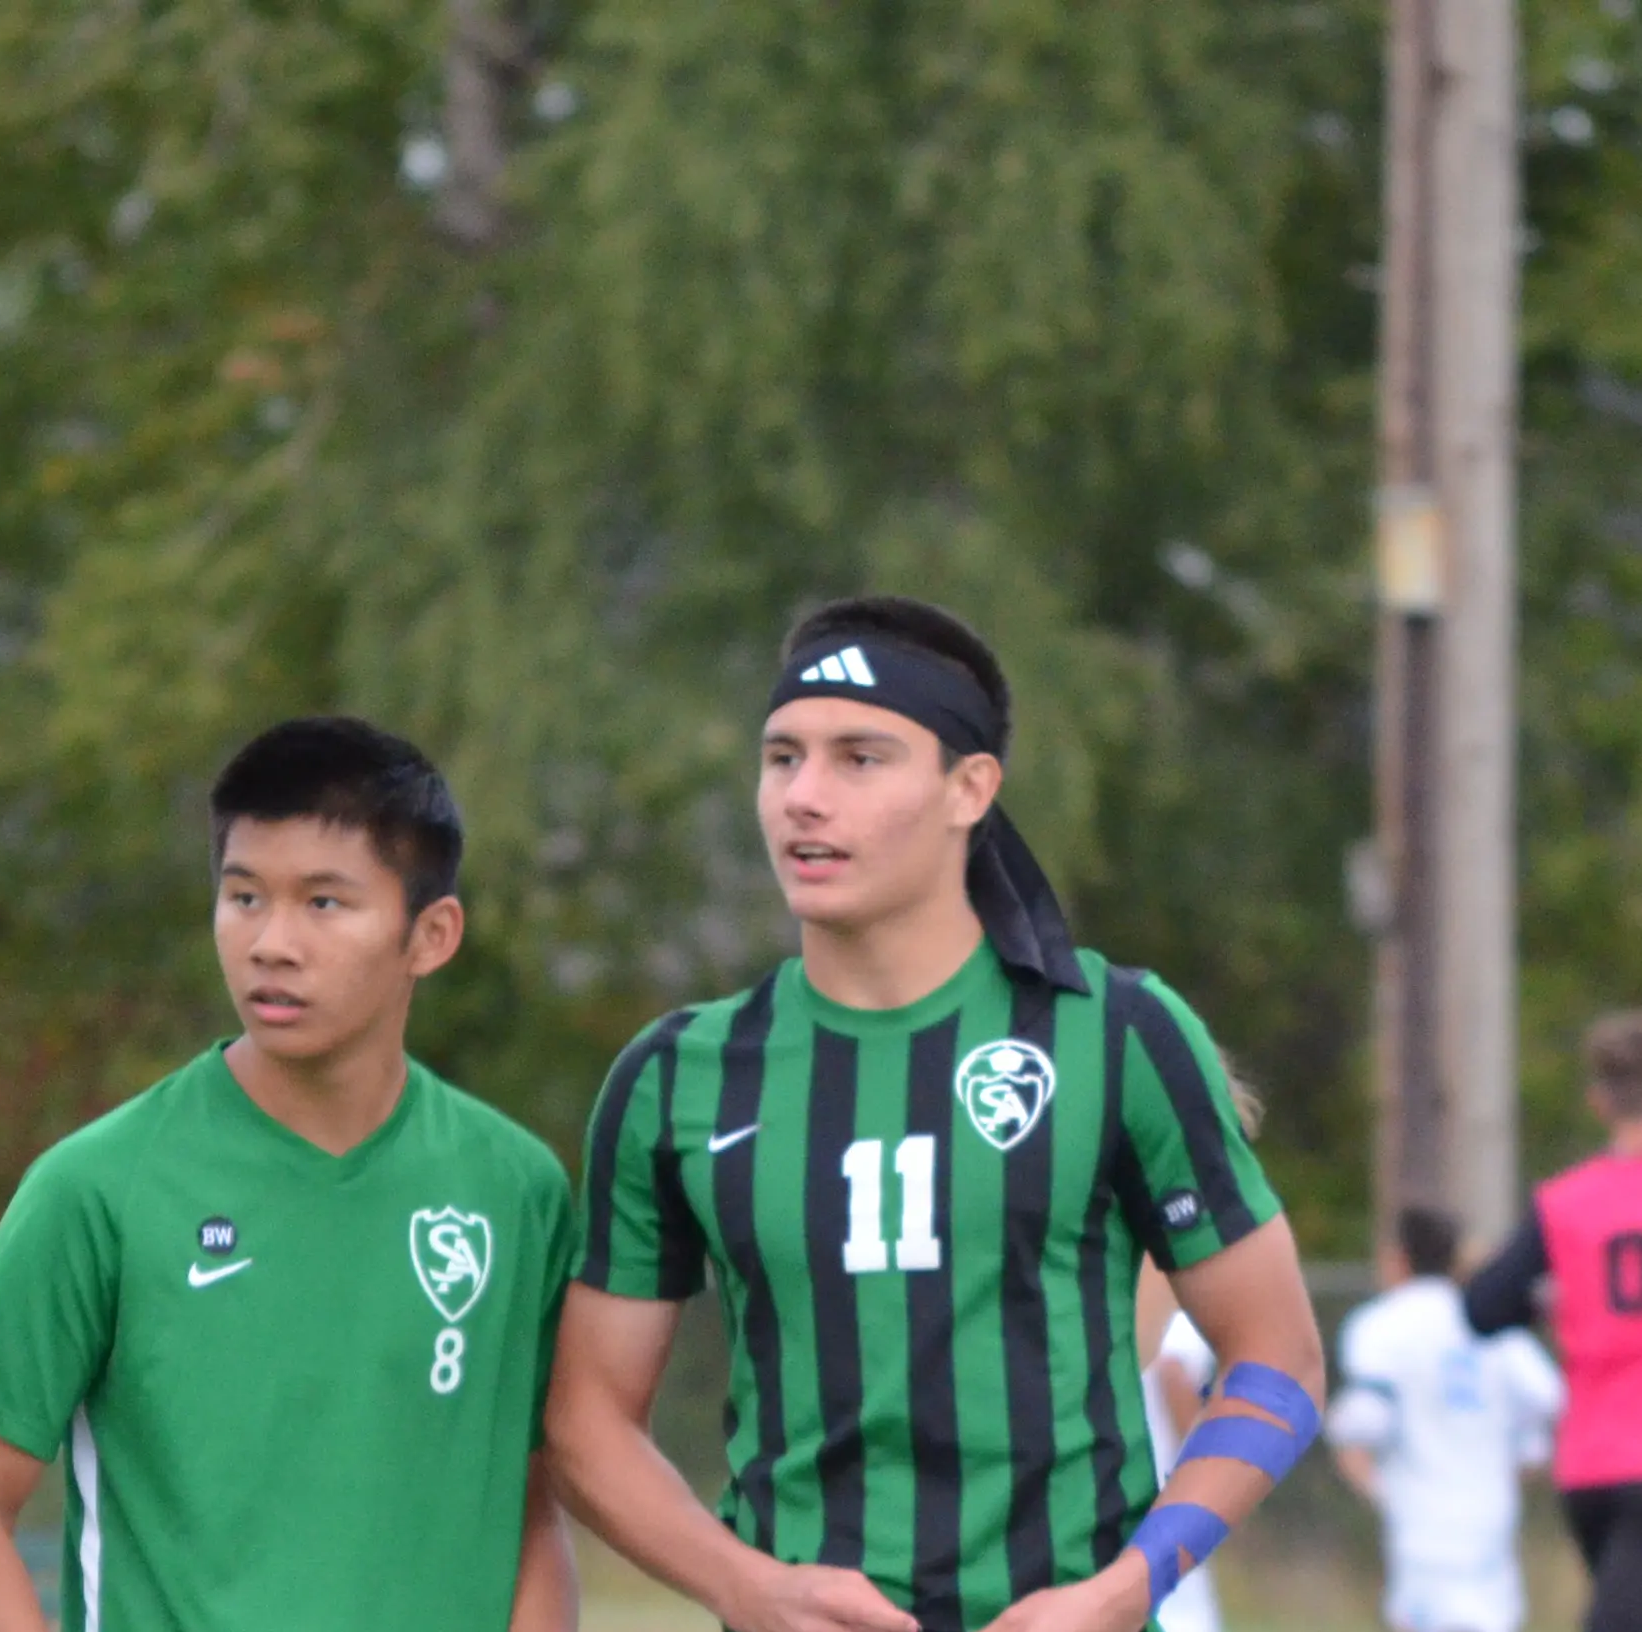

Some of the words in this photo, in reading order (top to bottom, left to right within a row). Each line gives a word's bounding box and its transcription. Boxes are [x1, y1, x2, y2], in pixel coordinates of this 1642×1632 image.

[202, 1225, 233, 1247] BW
[842, 1135, 941, 1274] 11
[430, 1327, 465, 1393] 8
